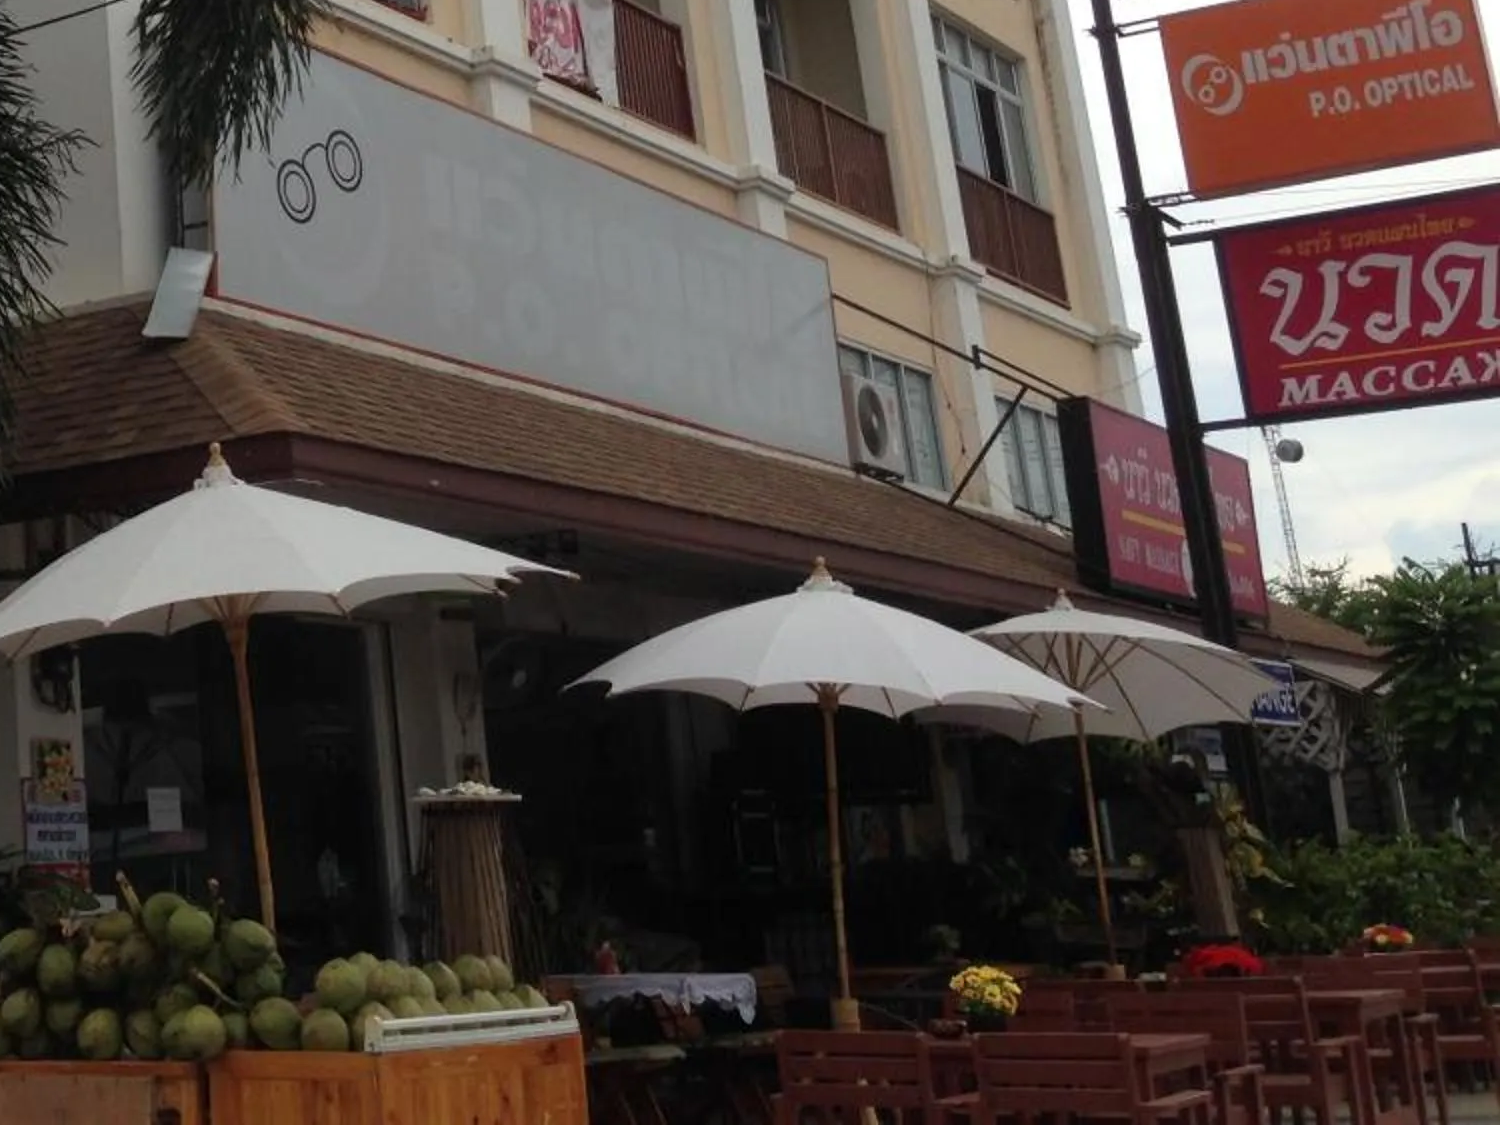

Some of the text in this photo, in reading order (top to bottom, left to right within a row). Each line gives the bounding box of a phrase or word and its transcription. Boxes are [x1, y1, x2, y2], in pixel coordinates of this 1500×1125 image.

[1309, 63, 1475, 119] P.O. OPTICAL
[1259, 240, 1500, 356] นวด
